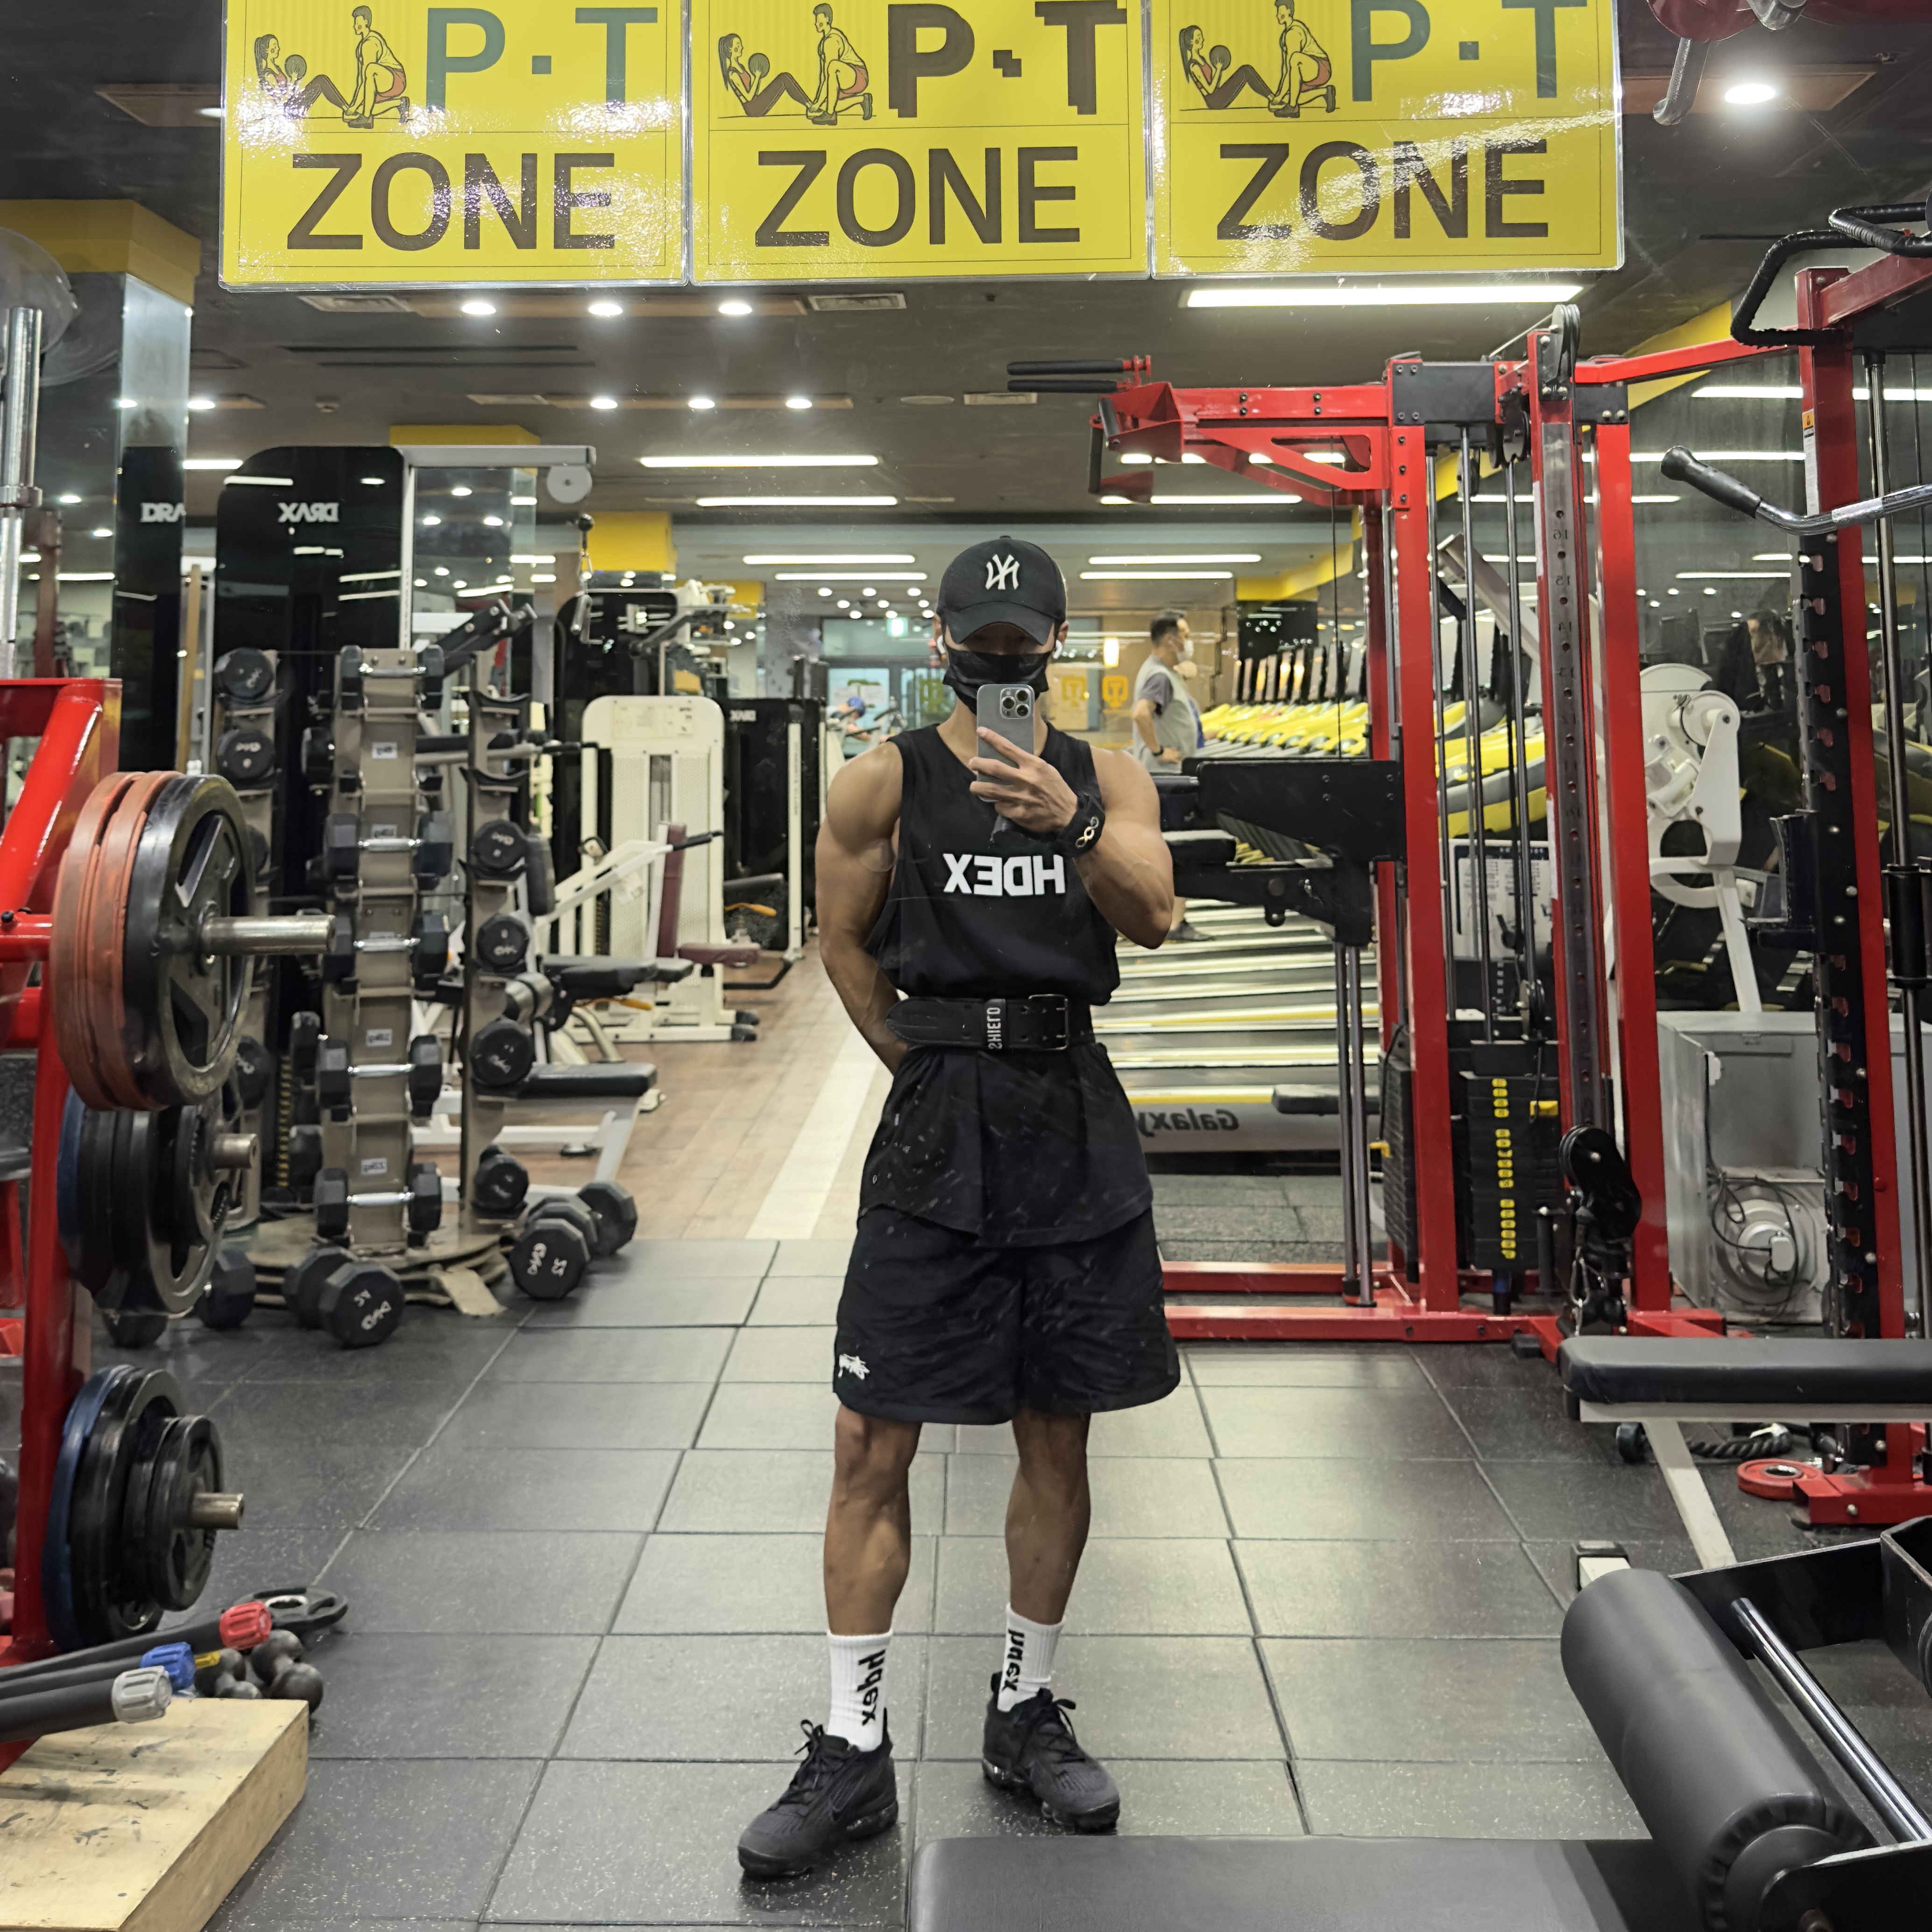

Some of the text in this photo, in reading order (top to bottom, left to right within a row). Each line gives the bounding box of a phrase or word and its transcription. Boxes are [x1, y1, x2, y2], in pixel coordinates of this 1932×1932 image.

[287, 152, 615, 251] ZONE
[755, 146, 1080, 247] ZONE
[1216, 139, 1549, 240] ZONE
